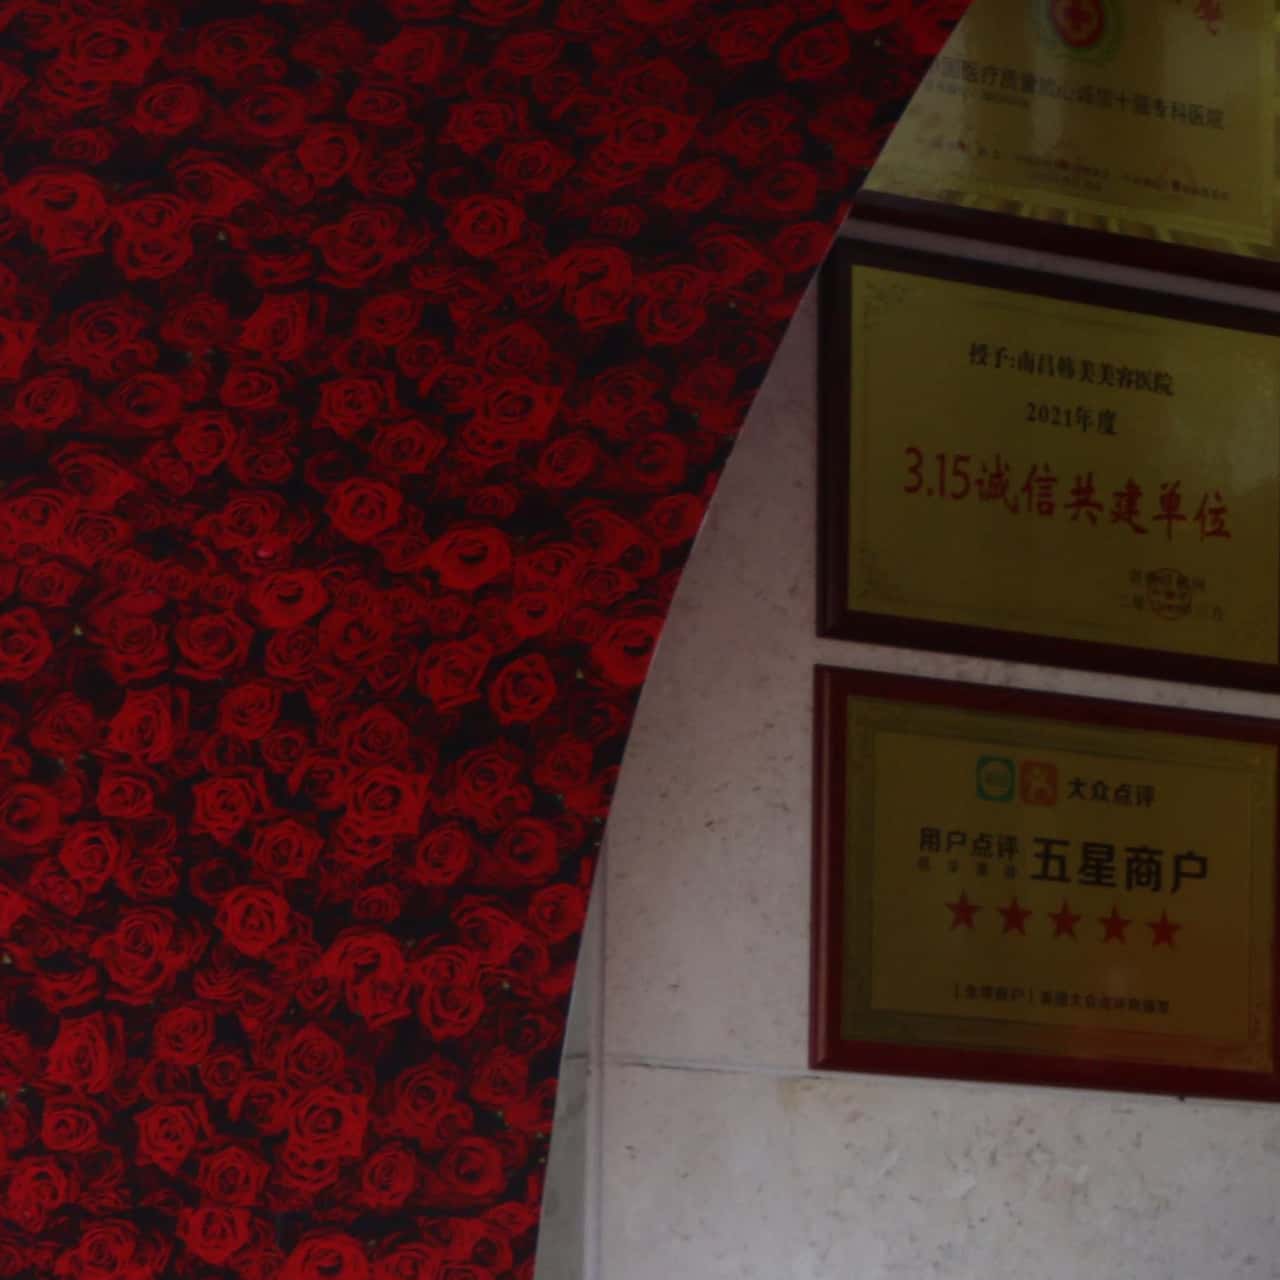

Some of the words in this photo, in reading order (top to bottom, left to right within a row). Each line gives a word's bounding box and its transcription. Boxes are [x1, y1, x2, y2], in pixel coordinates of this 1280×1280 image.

[1025, 401, 1118, 435] 2021年度
[904, 447, 1232, 541] 3.15诚信共建单位
[1067, 777, 1156, 807] 大众点评
[919, 827, 1020, 860] 用户点评
[1031, 836, 1208, 894] 五星商户
